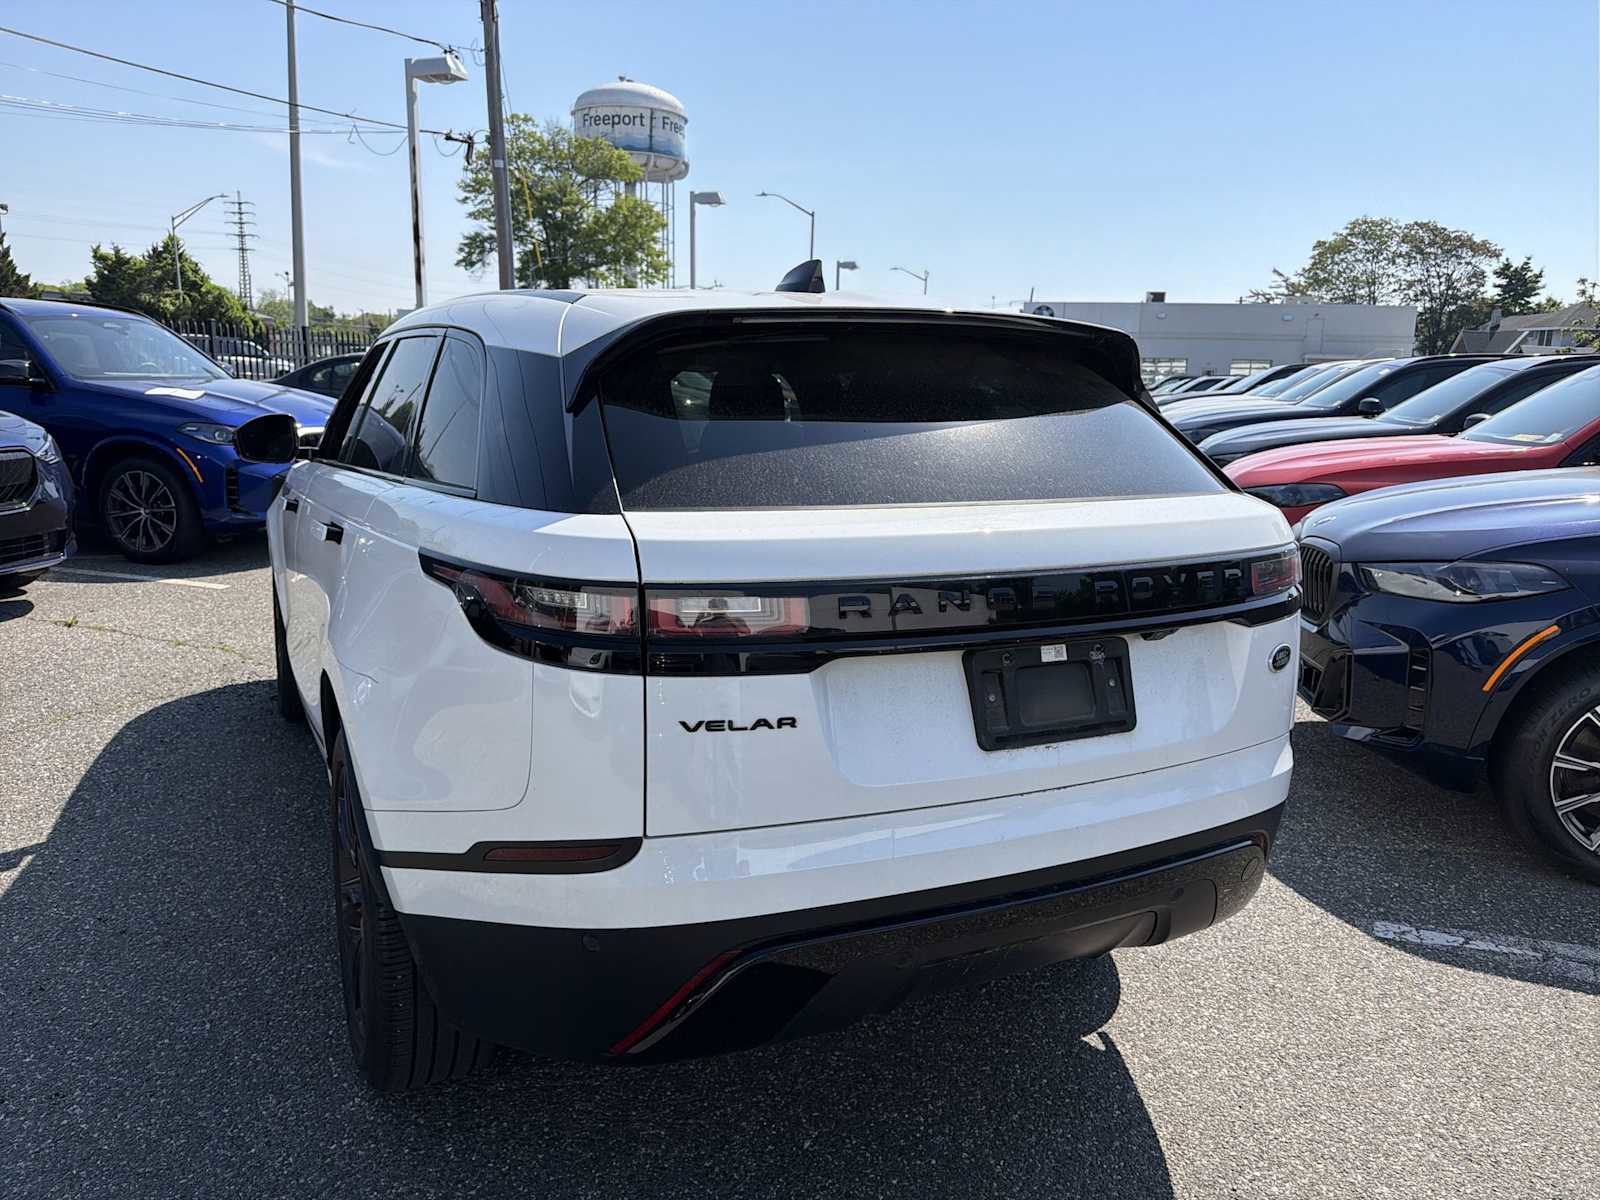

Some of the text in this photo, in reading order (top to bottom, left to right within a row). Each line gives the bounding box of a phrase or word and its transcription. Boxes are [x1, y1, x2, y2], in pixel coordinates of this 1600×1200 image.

[582, 112, 646, 129] Freeport
[837, 568, 1242, 618] RANGE ROVER
[678, 716, 798, 733] VELAR
